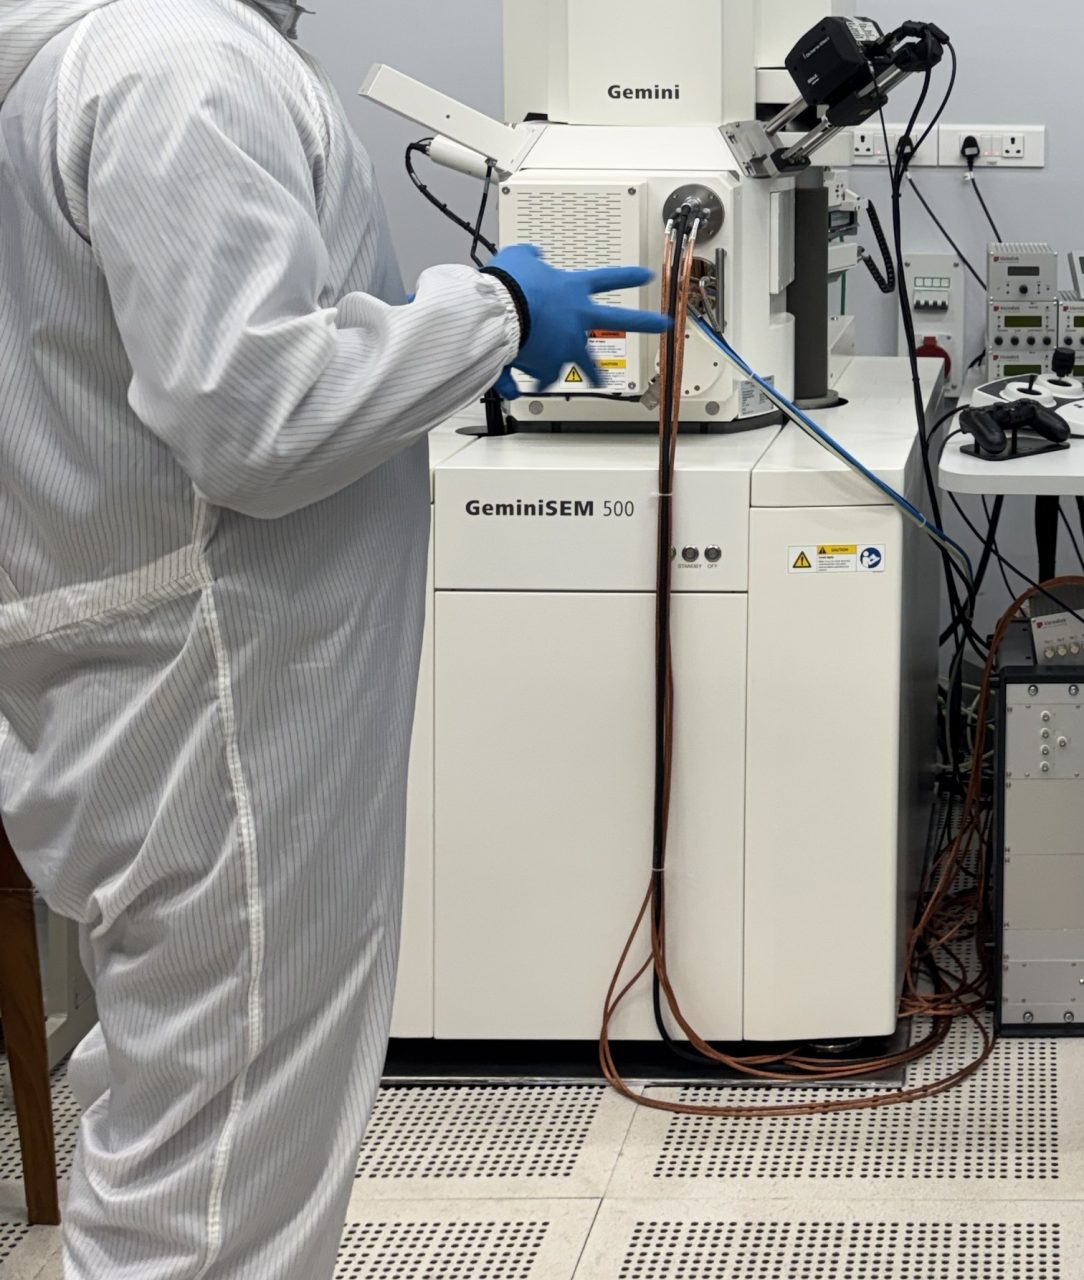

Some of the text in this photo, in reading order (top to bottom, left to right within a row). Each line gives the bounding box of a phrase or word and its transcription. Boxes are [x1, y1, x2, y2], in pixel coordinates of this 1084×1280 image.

[607, 84, 680, 100] Gemini
[465, 499, 634, 517] GeminiSEM 500
